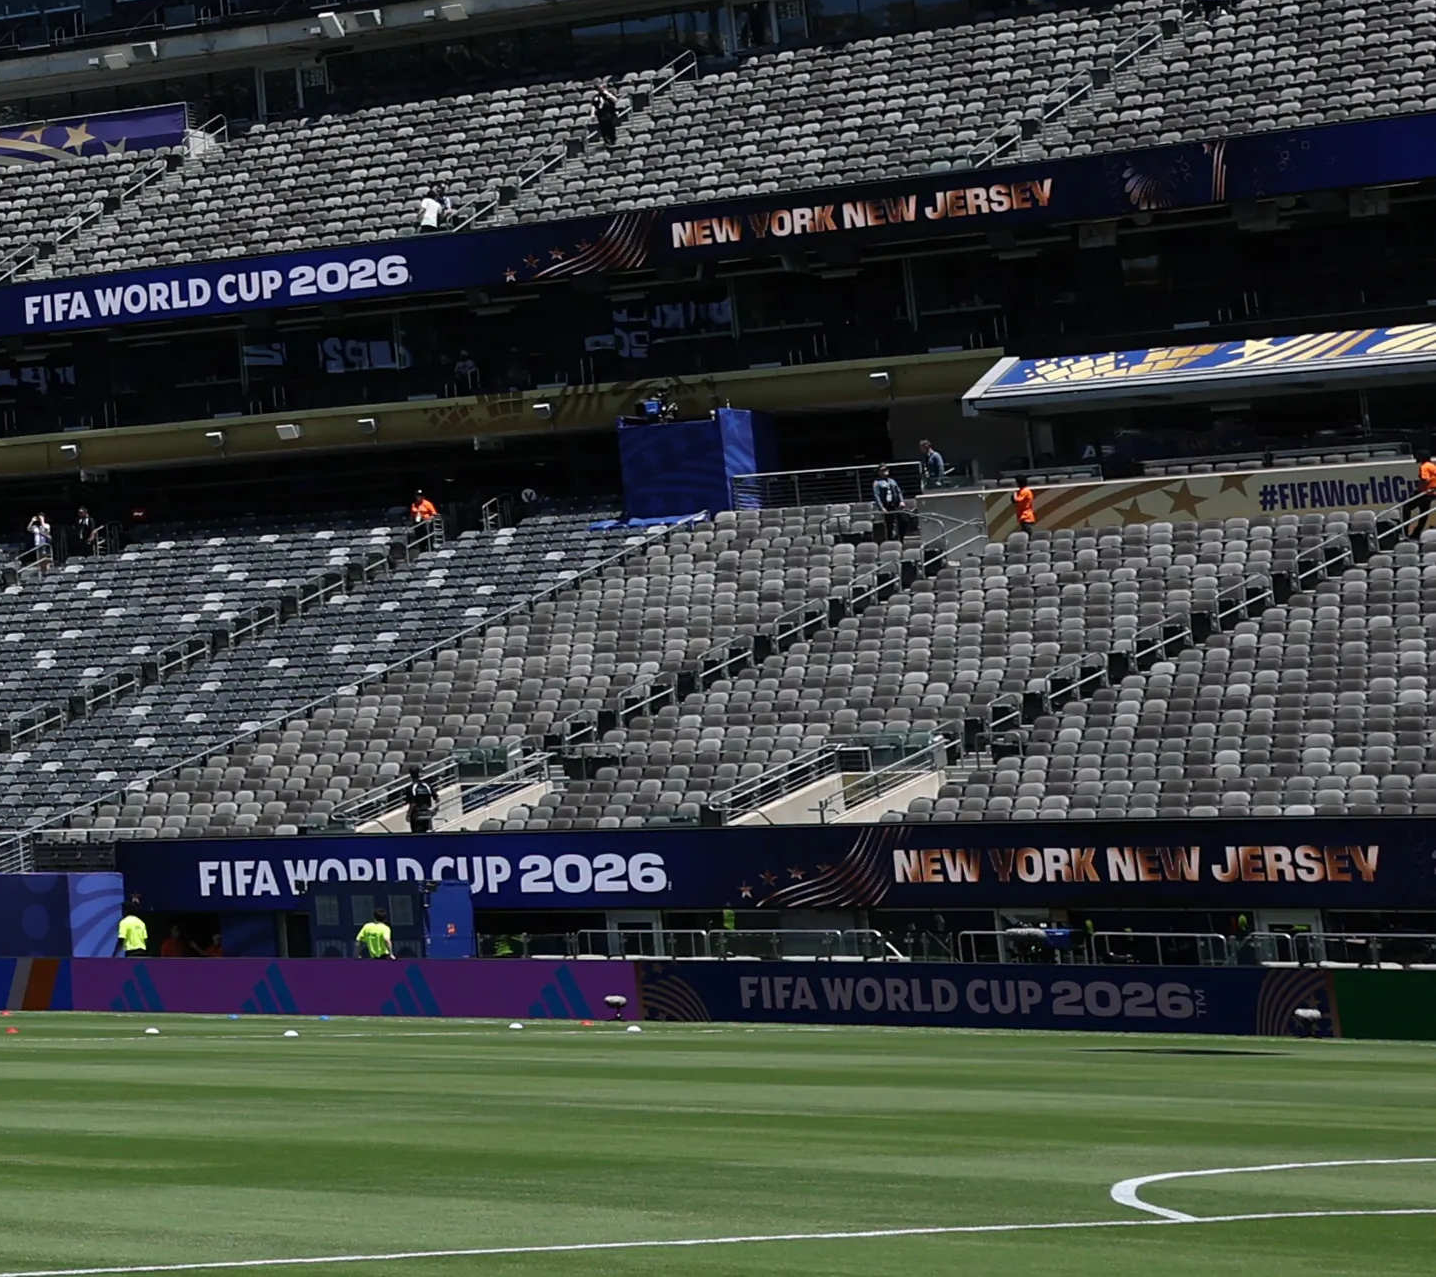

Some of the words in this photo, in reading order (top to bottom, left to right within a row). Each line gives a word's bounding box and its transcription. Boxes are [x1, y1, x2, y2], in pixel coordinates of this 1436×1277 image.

[672, 213, 743, 249] NEW
[748, 203, 838, 242] YORK
[842, 193, 918, 230] NEW
[925, 177, 1054, 221] JERSEY
[25, 291, 91, 326] FIFA
[95, 278, 212, 319] WORLD
[216, 269, 284, 306] CUP
[288, 253, 410, 298] 2026
[197, 859, 278, 899] FIFA
[519, 851, 668, 894] 2026
[893, 848, 981, 884] NEW
[990, 847, 1099, 883] YORK
[1107, 847, 1200, 883] NEW
[1210, 845, 1380, 882] JERSEY
[739, 975, 818, 1011] FIFA
[822, 977, 957, 1014] WORLD
[965, 980, 1043, 1015] CUP
[1051, 981, 1193, 1019] 2026
